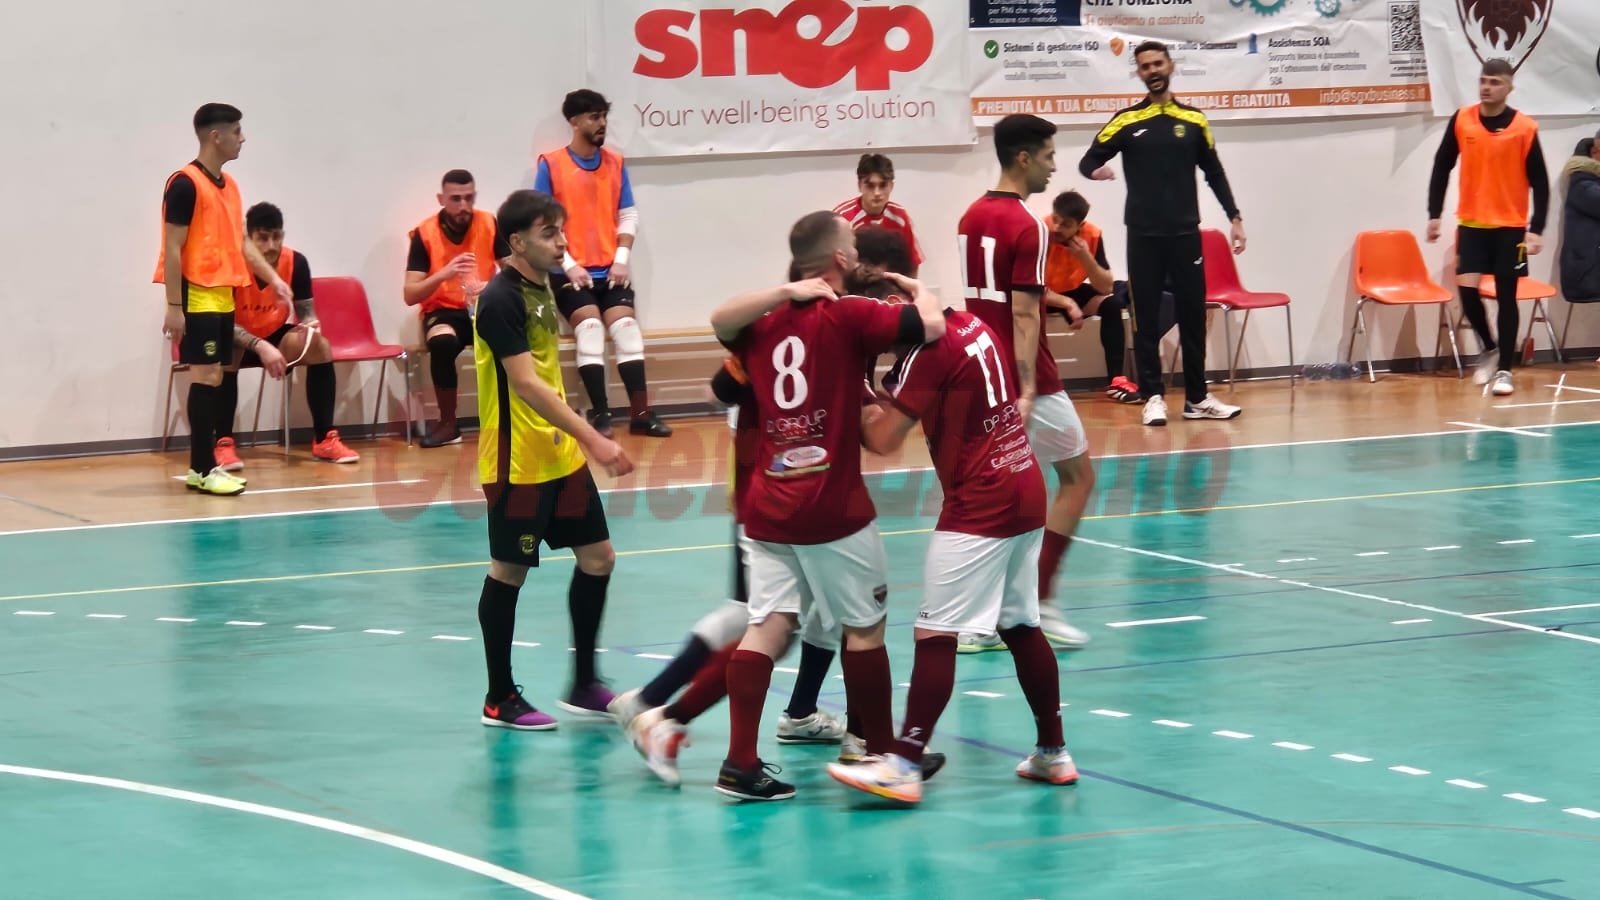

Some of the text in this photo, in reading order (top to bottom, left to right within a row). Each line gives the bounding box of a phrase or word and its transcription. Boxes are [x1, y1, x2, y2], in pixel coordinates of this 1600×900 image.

[633, 0, 934, 90] snep
[1003, 41, 1099, 54] Sistemi di gestione ISO
[1312, 36, 1330, 46] SOA
[633, 102, 694, 127] Your
[836, 95, 936, 121] solution
[977, 100, 1034, 114] PRENOTA
[1036, 100, 1052, 113] LA
[1056, 99, 1081, 113] TUA
[1232, 93, 1290, 107] GRATUITA
[772, 335, 809, 410] 8
[776, 409, 828, 432] GROUP
